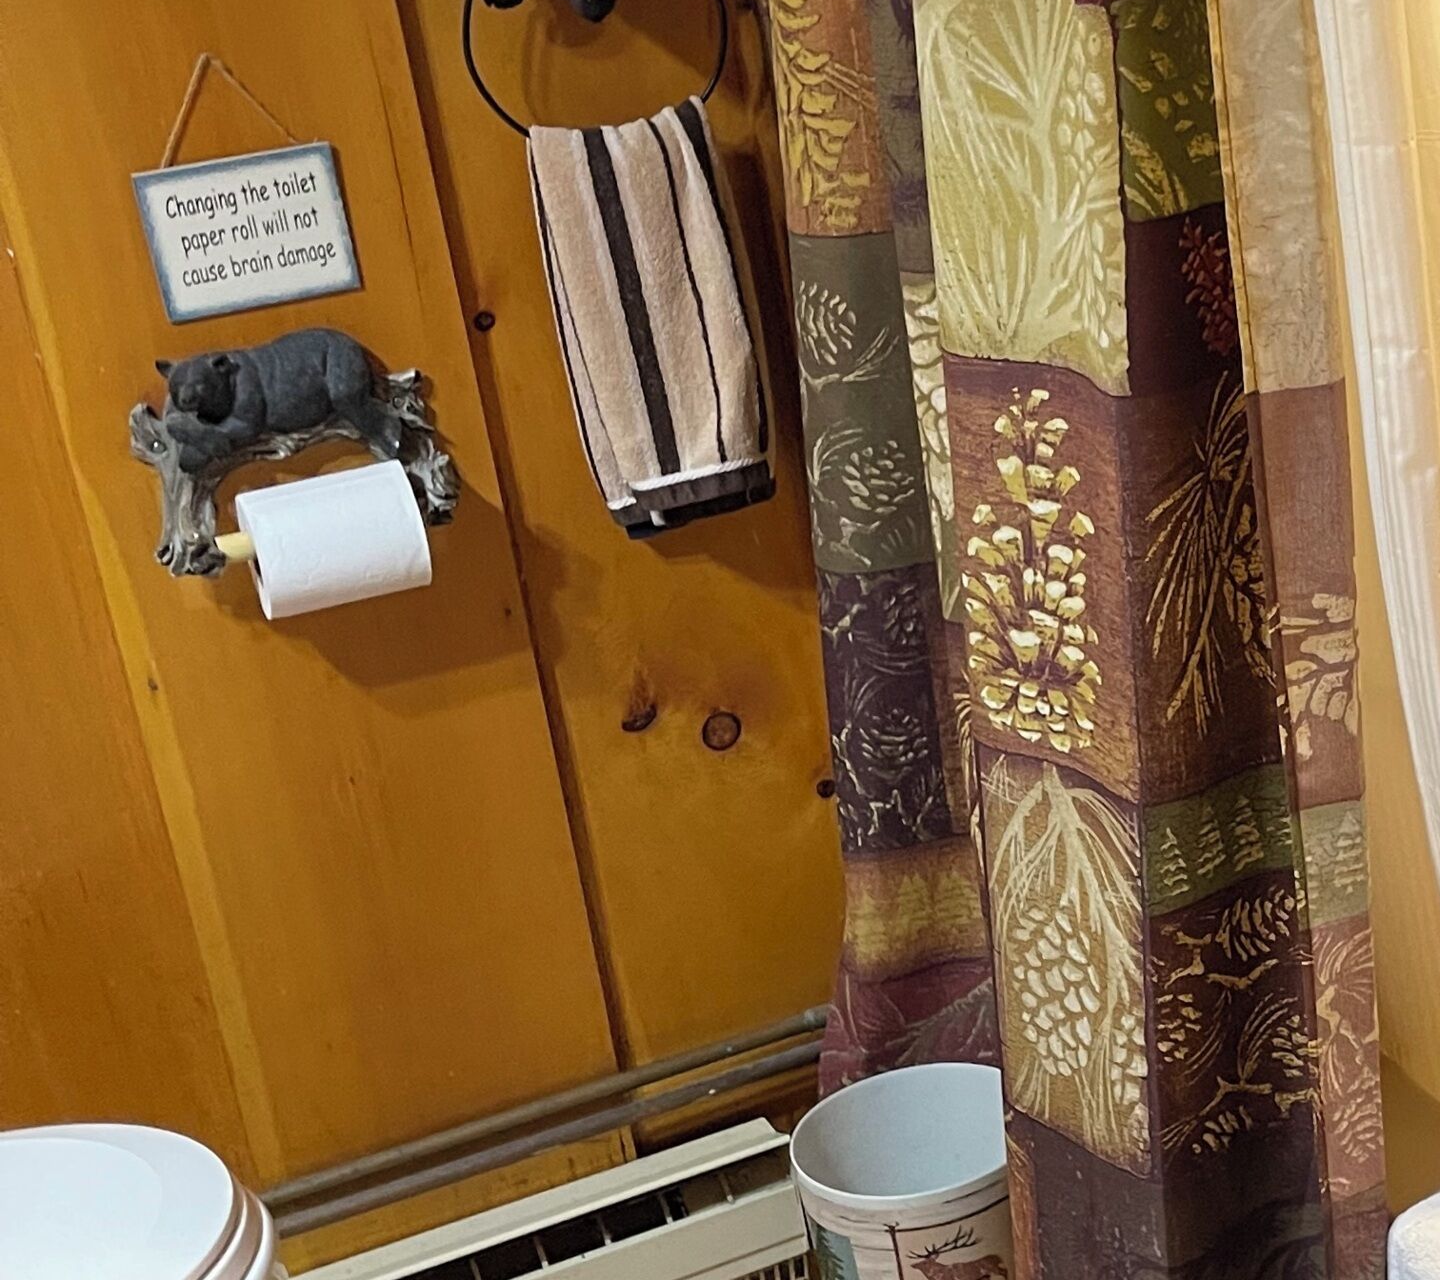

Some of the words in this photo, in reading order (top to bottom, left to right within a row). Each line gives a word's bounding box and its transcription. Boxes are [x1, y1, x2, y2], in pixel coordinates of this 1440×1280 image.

[166, 189, 238, 219] Changing
[241, 180, 270, 206] the
[273, 171, 317, 199] toilet
[181, 226, 226, 260] paper
[231, 216, 259, 243] roll
[262, 209, 290, 237] will
[294, 205, 319, 231] not
[182, 262, 228, 287] cause
[229, 250, 274, 277] brain
[277, 242, 337, 267] damage
